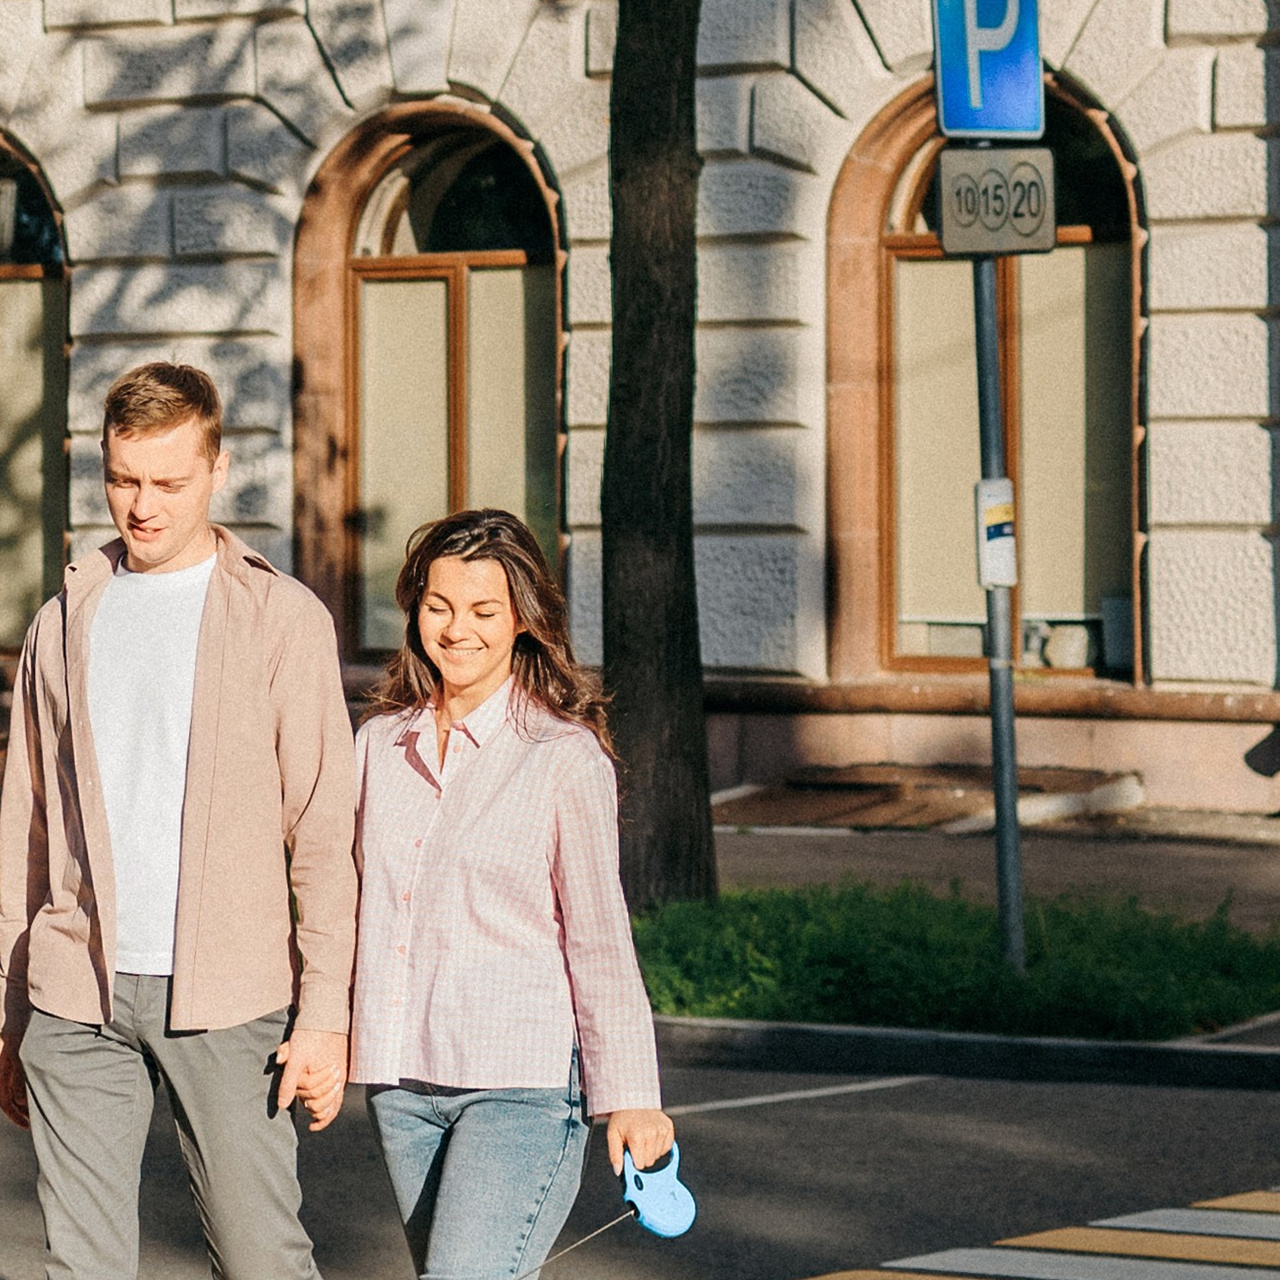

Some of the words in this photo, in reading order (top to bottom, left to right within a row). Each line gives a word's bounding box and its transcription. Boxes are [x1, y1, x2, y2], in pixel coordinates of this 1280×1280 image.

[955, 185, 976, 215] 10
[982, 184, 1004, 217] 15
[1013, 181, 1040, 218] 20
